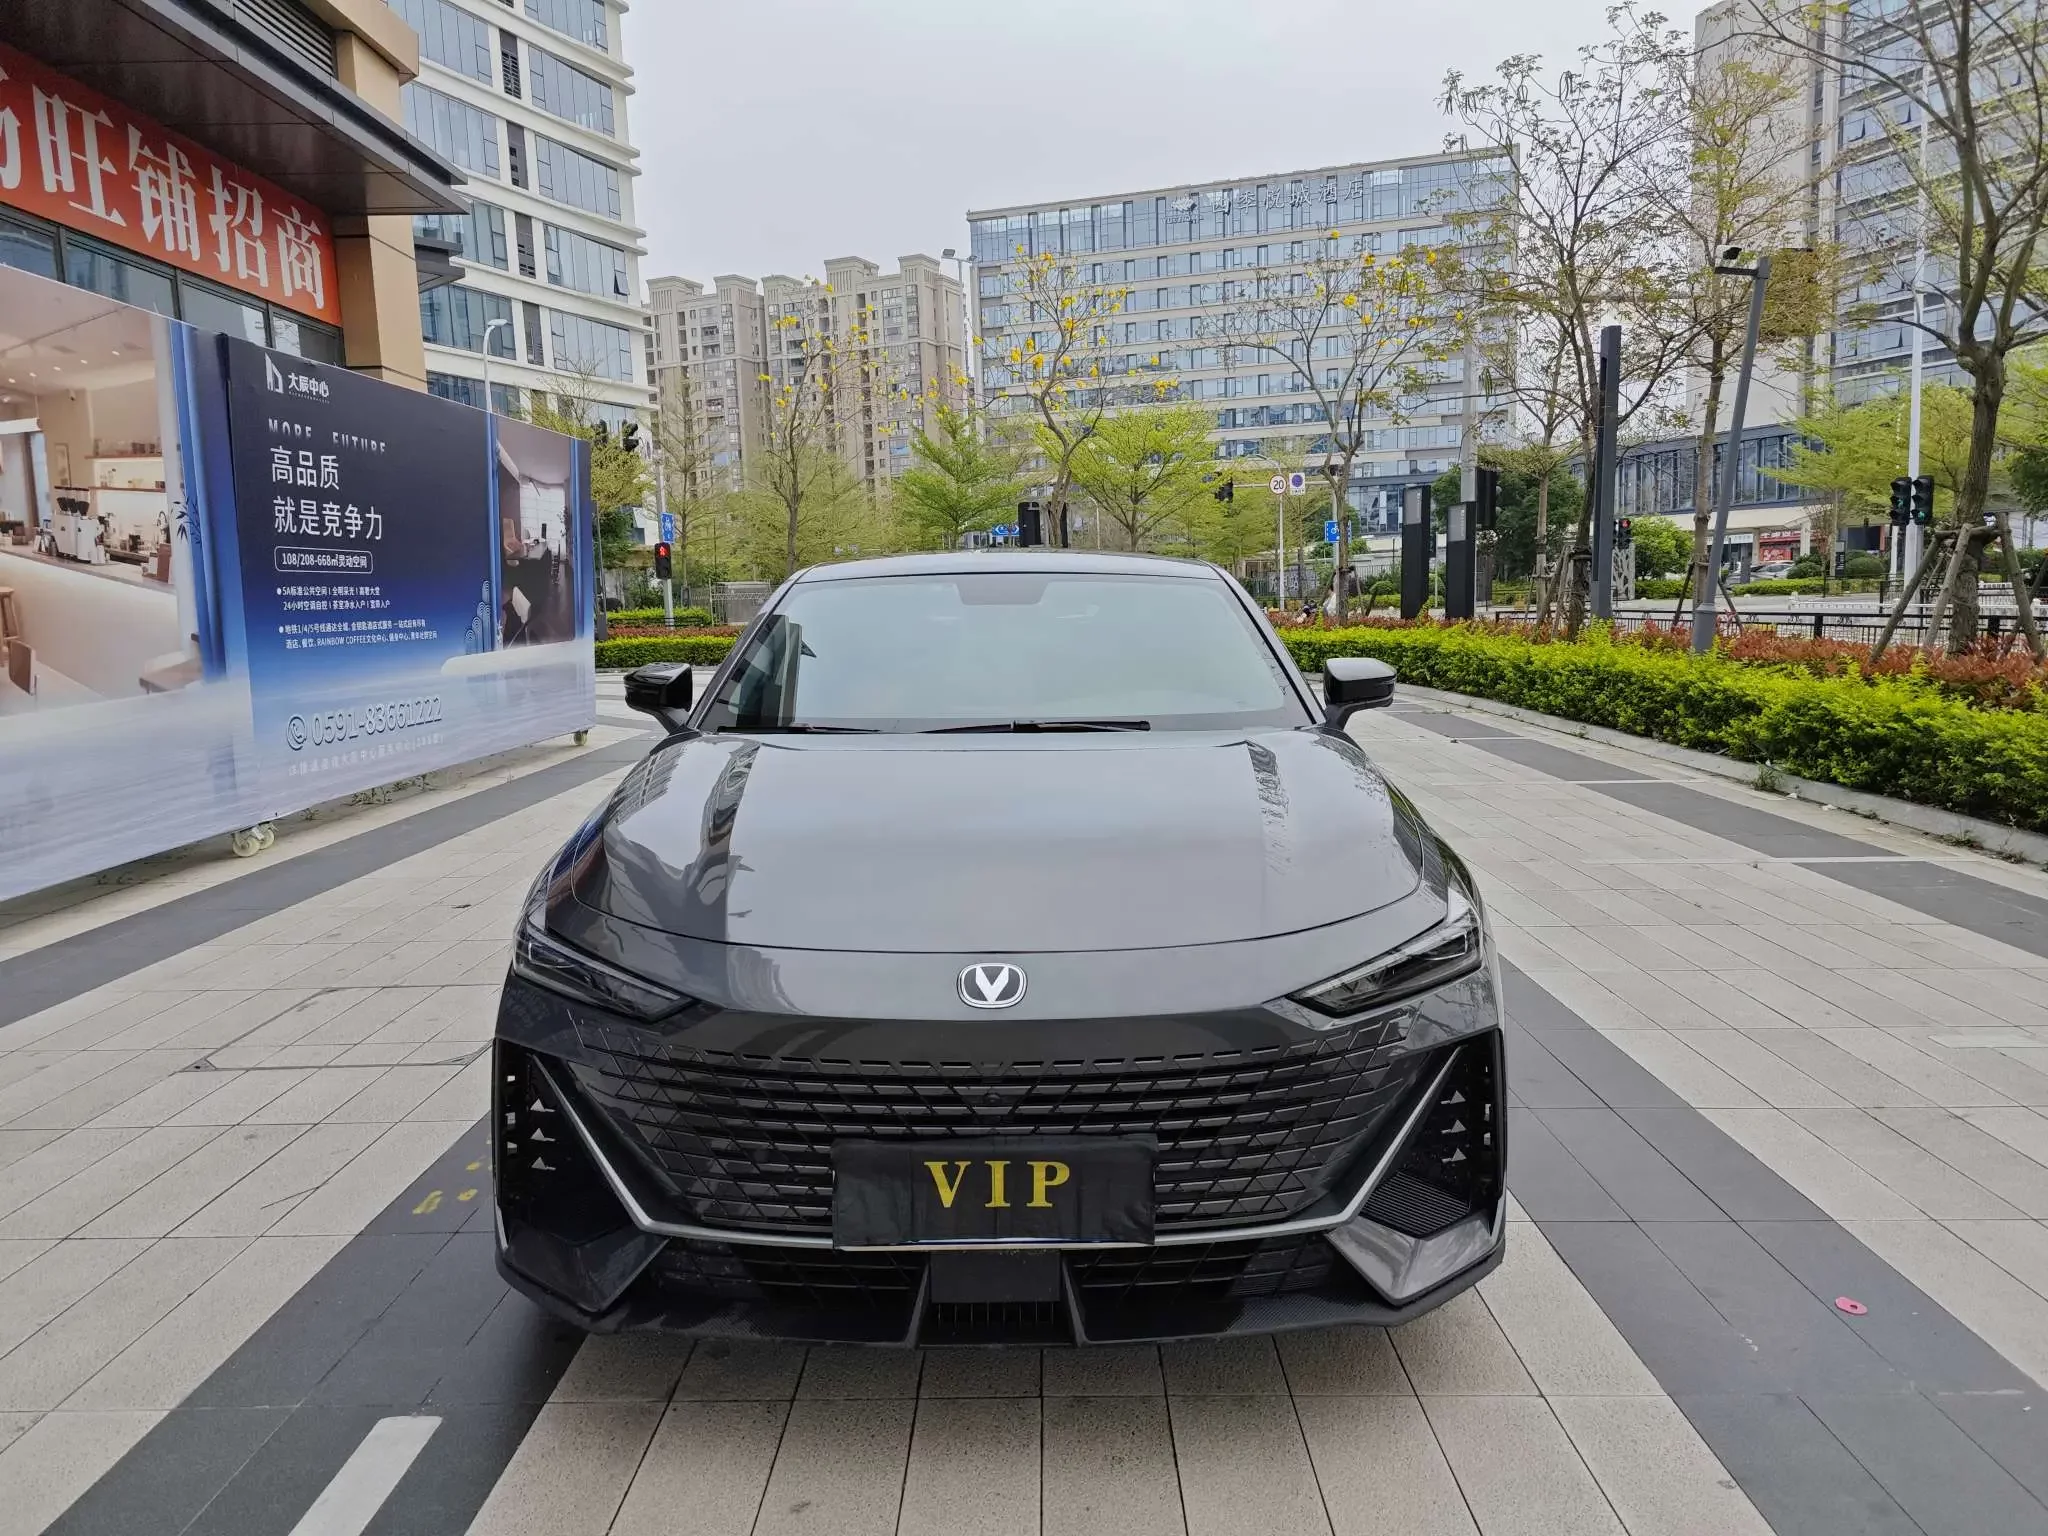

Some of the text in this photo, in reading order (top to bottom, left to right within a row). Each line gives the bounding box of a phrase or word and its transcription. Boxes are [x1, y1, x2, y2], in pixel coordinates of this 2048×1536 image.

[0, 65, 325, 310] 旺铺招商
[1211, 179, 1364, 215] 四季悦城酒店
[270, 445, 340, 490] 高品质
[1273, 480, 1284, 490] 20
[273, 496, 382, 540] 就是竞争力
[311, 694, 443, 746] 0591-83661222
[923, 1160, 1071, 1208] VIP
